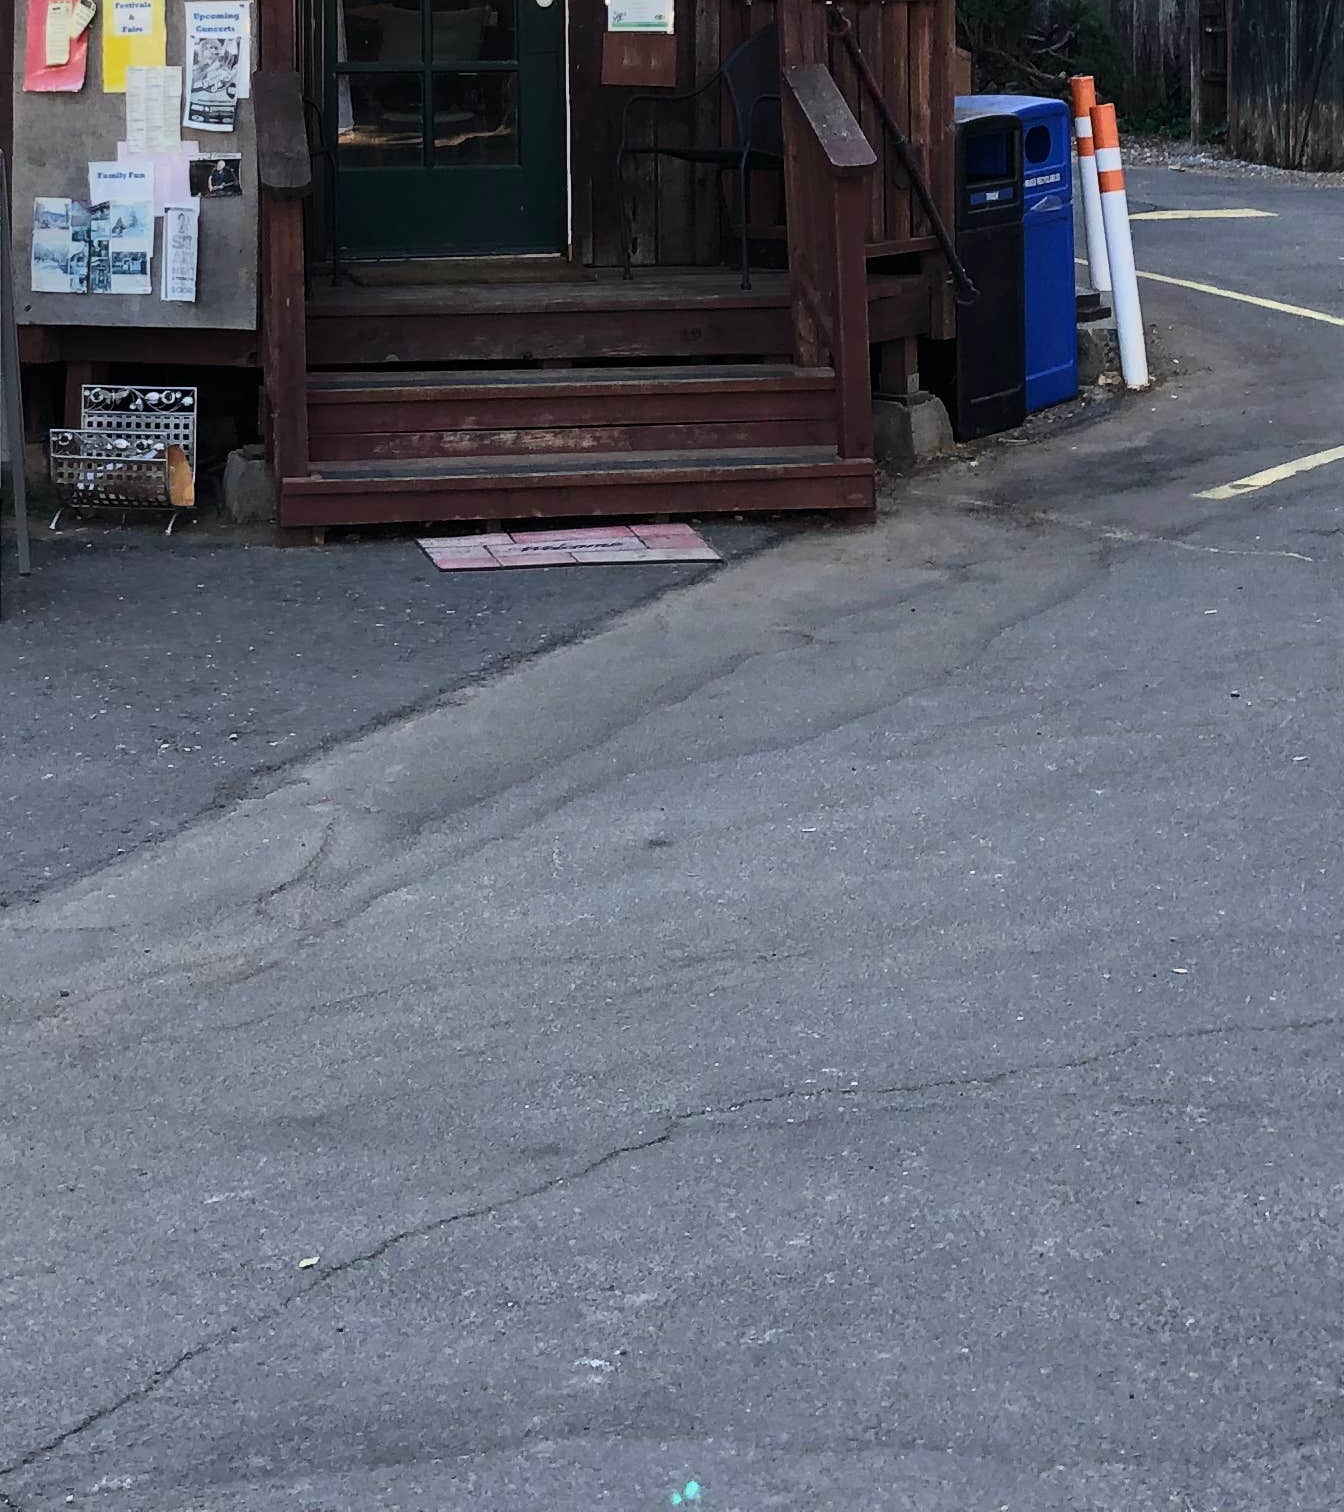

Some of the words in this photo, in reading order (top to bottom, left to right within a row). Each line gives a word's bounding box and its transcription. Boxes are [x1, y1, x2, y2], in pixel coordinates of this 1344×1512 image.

[193, 12, 240, 22] Upcoming
[195, 25, 236, 33] Concerts
[97, 172, 127, 181] Family
[128, 171, 145, 180] Fun
